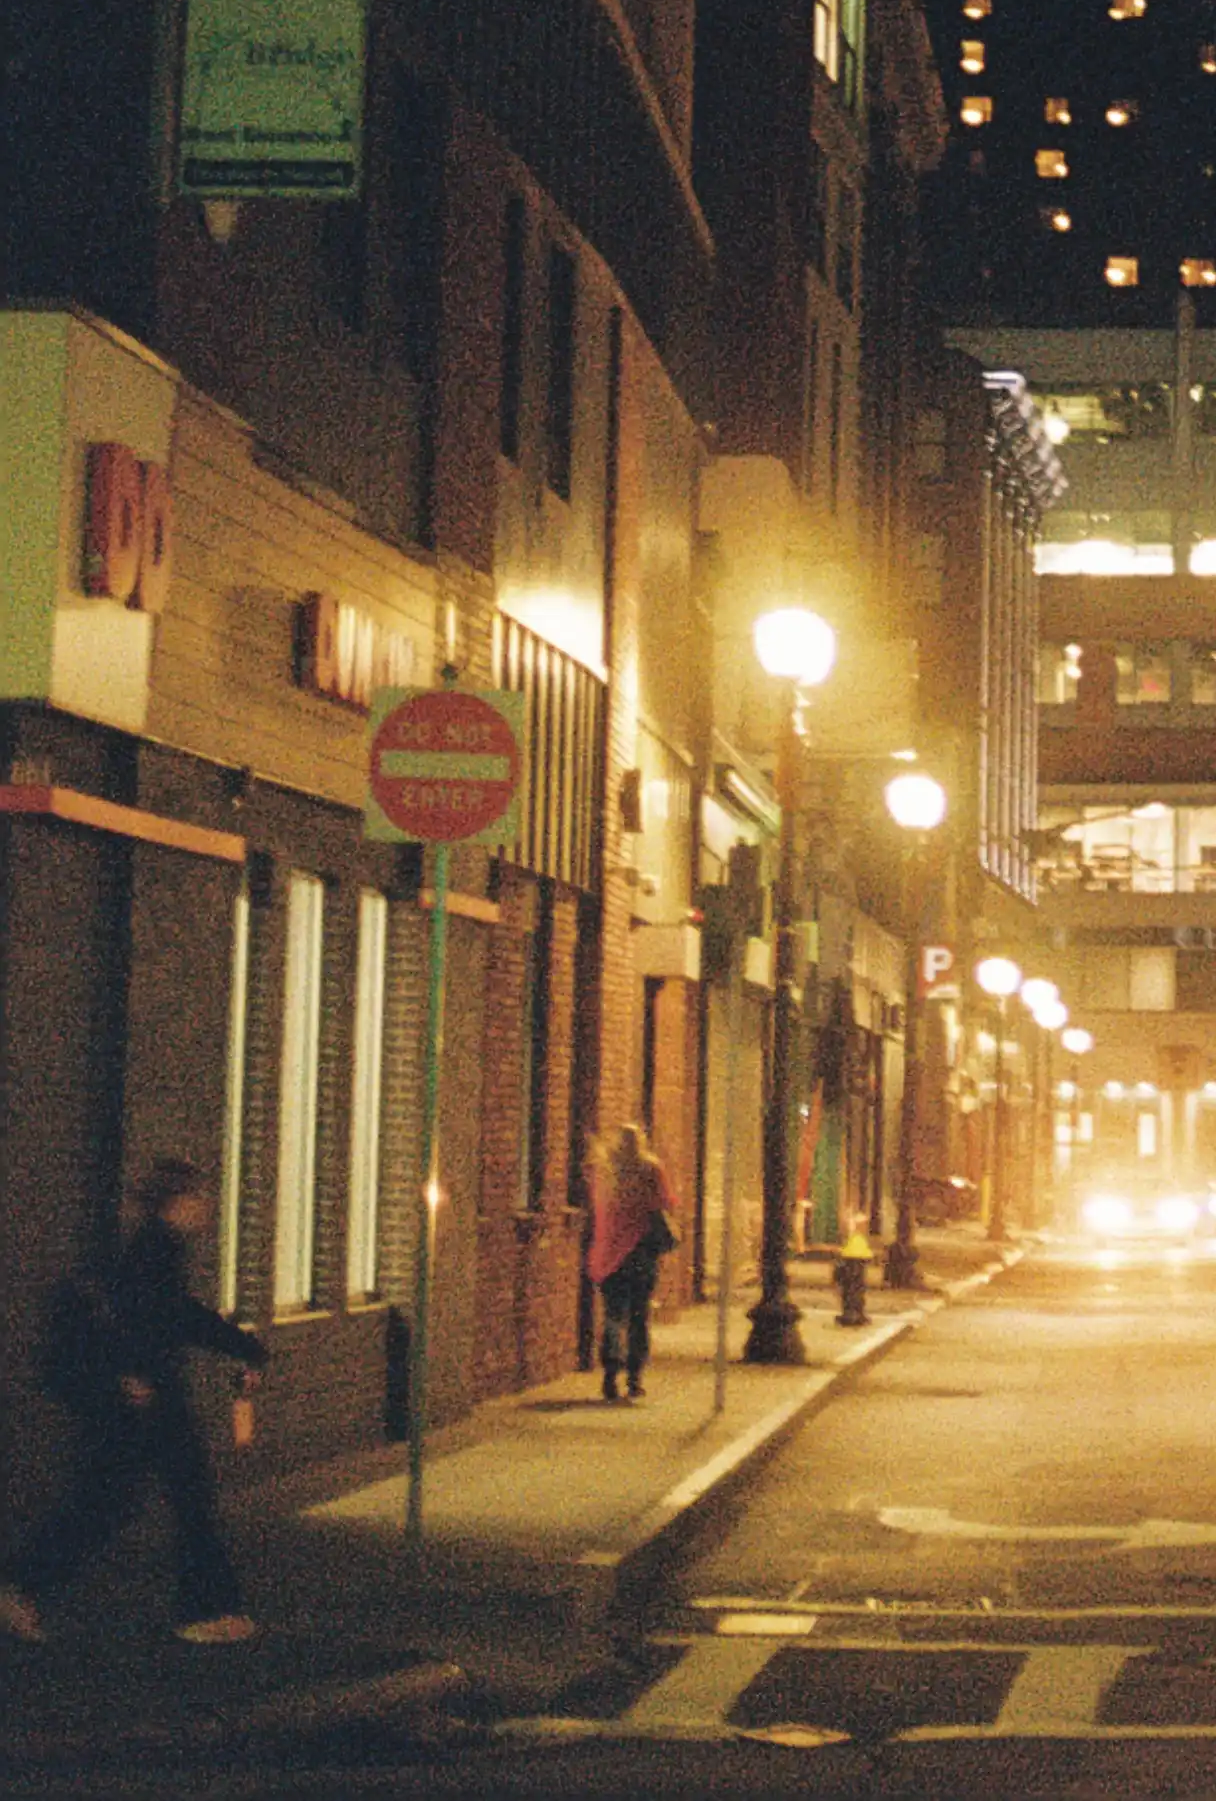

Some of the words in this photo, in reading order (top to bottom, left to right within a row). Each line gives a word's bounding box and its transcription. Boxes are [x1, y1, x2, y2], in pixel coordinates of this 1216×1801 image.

[398, 721, 432, 744] DO
[446, 724, 493, 746] NOT
[402, 785, 484, 811] ENTER
[924, 946, 953, 983] P
